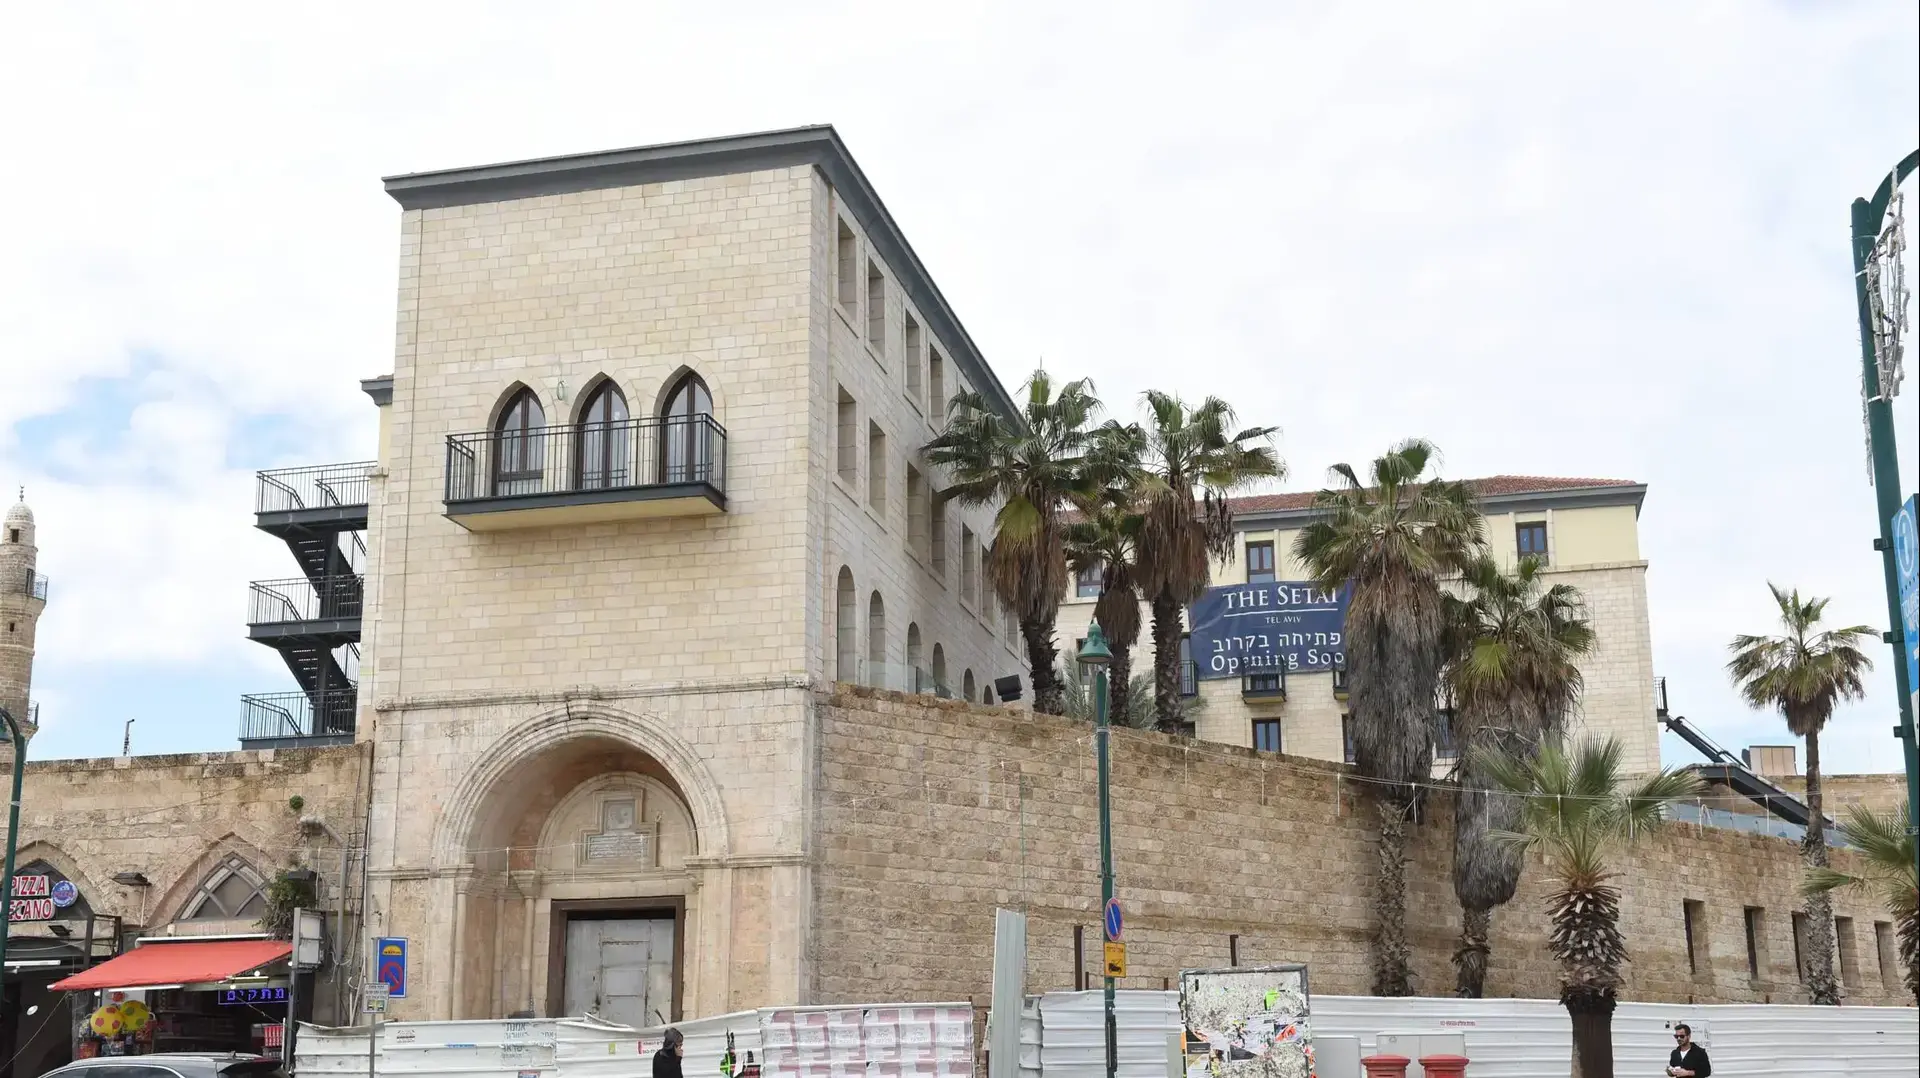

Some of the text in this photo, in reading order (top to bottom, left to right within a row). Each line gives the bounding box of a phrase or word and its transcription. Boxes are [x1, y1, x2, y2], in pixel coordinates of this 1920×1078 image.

[1222, 589, 1269, 609] THE
[1265, 615, 1302, 624] TEL AVIV
[1212, 632, 1341, 653] פתיחה בקרוב
[1307, 648, 1345, 666] Soo
[11, 875, 46, 896] PIZZA
[8, 899, 52, 920] ECANO
[226, 987, 285, 1001] מתקים
